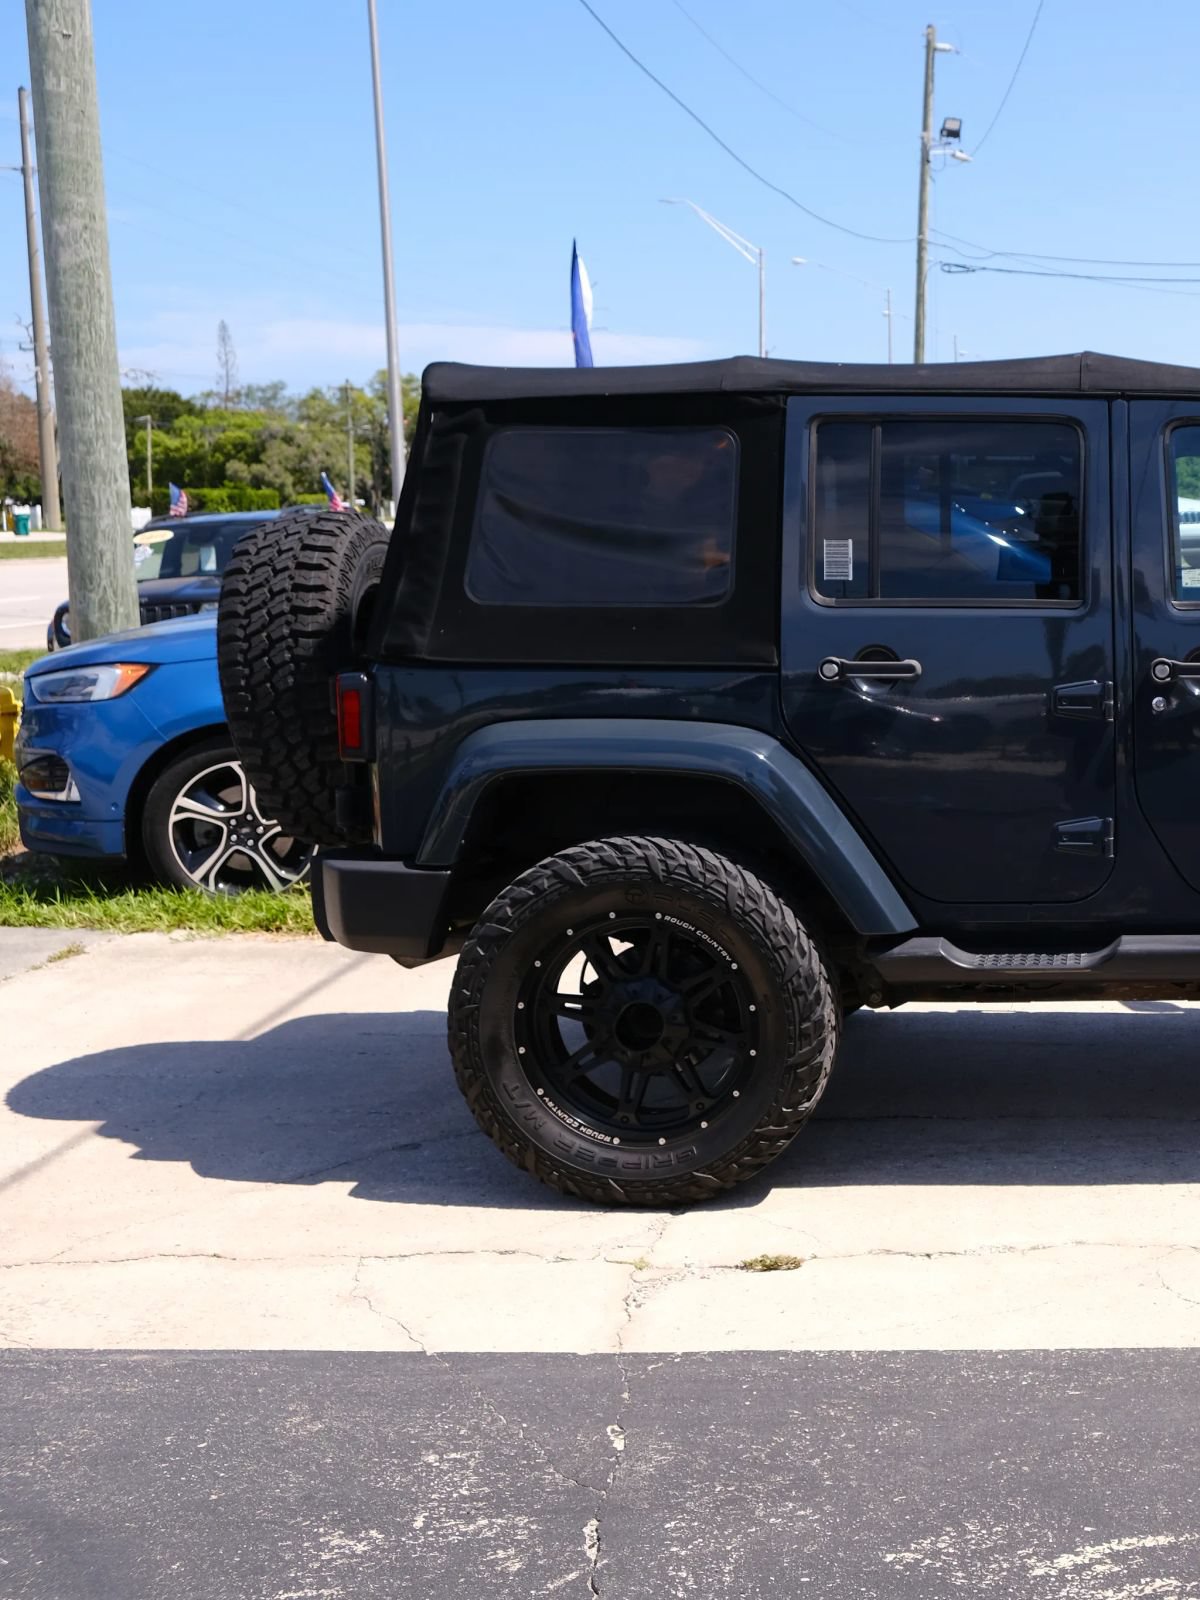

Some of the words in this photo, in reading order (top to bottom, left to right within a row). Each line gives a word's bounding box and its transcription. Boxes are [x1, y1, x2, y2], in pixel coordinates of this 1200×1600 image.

[664, 915, 695, 931] ROUGH
[696, 930, 732, 961] COUNTRY
[502, 1081, 547, 1131] M/T
[543, 1096, 579, 1127] COUNTRY
[553, 1132, 697, 1169] GRIPPER
[579, 1125, 611, 1142] ROUGH
